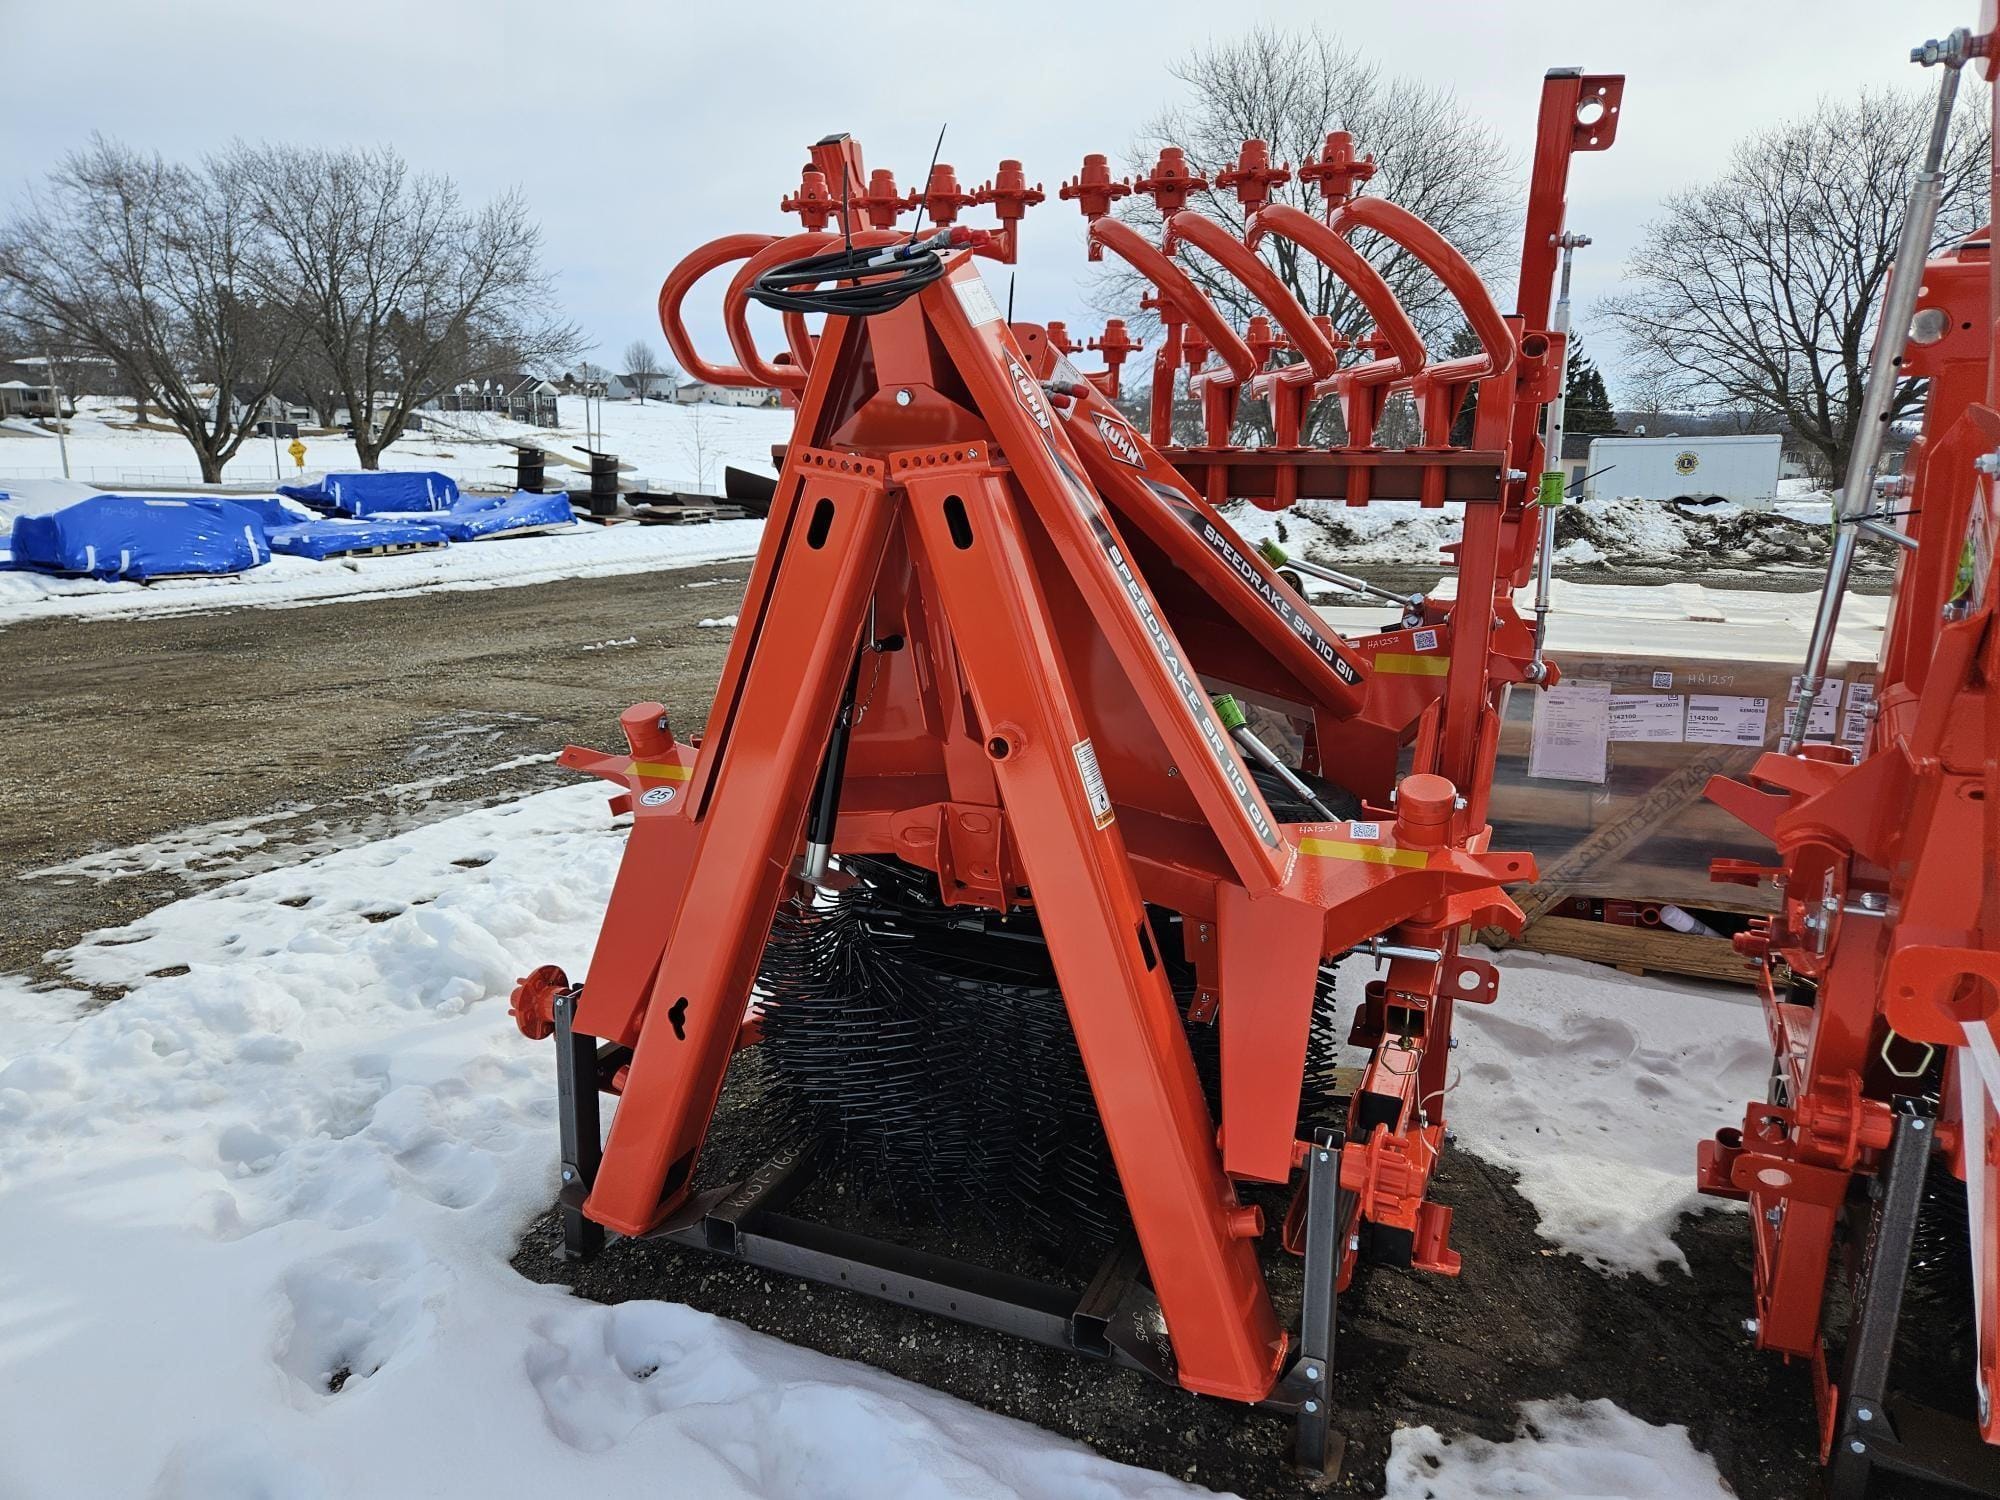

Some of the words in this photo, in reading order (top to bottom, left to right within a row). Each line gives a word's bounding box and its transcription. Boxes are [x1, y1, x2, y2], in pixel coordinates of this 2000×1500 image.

[1009, 362, 1050, 430] KUHN
[1099, 417, 1139, 465] KUHN
[1203, 523, 1291, 619] SPEEDRAKE
[1293, 615, 1313, 641] SR
[1315, 637, 1334, 662] 110
[1108, 545, 1201, 712] SPEEDRAKE
[1201, 716, 1226, 756] SR
[1225, 759, 1248, 798] 110
[648, 790, 671, 800] 25
